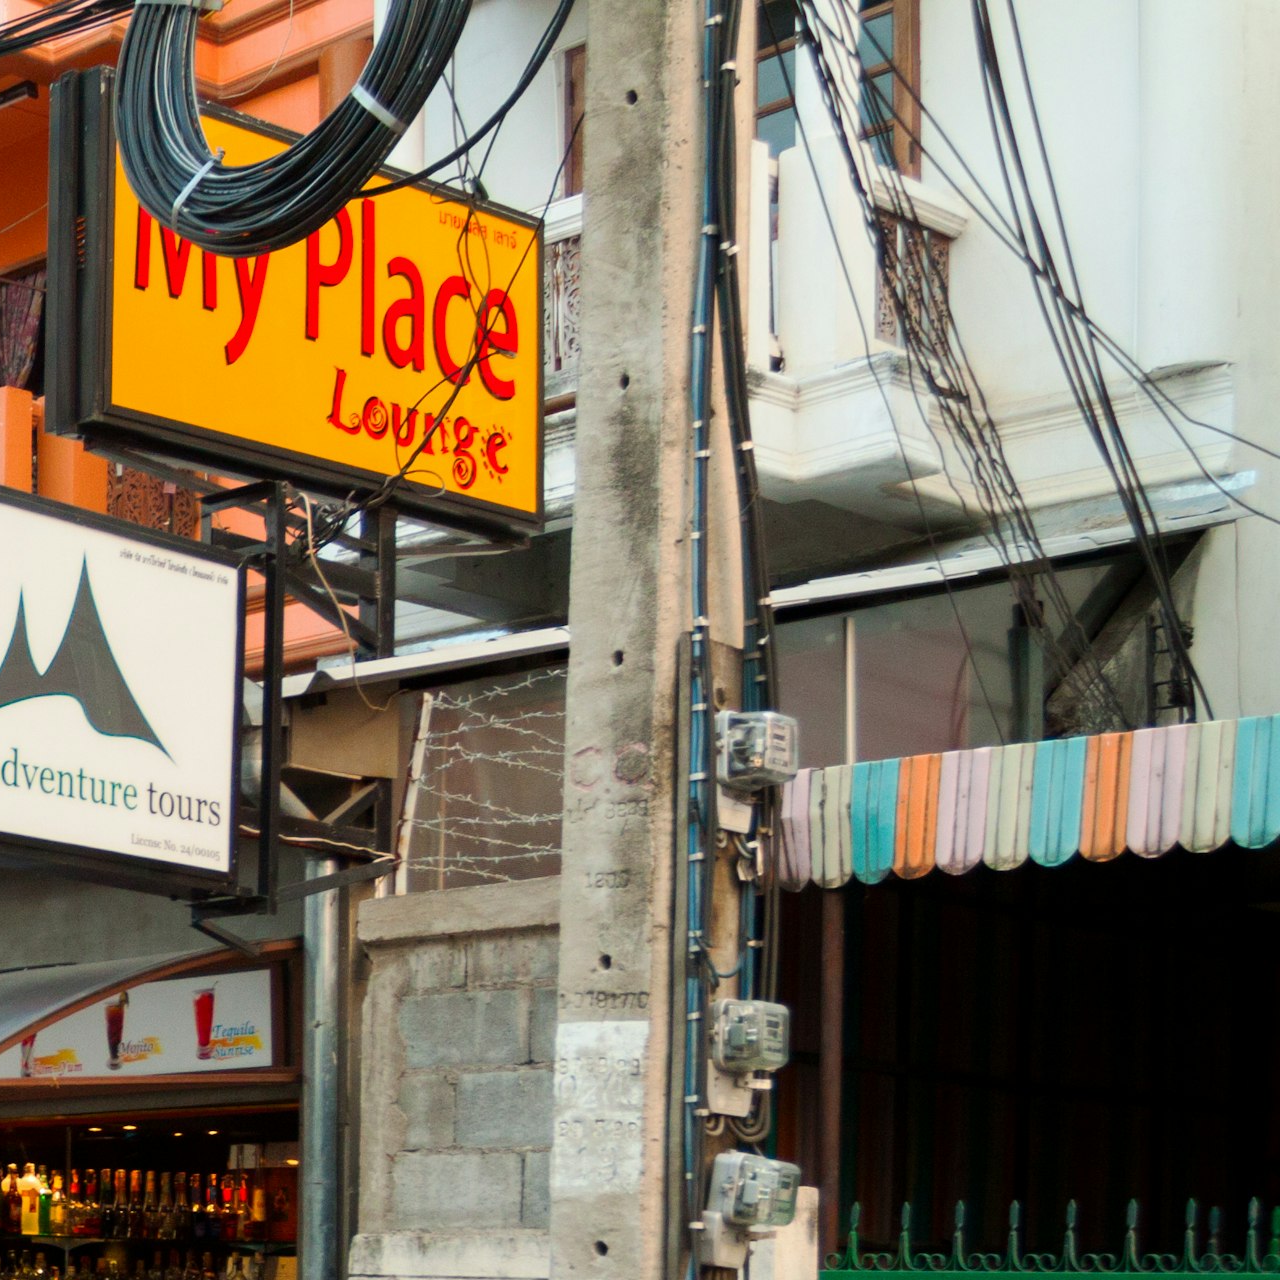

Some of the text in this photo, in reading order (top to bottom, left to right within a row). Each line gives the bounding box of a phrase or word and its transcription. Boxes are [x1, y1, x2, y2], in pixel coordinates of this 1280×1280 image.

[134, 198, 518, 401] My Place
[327, 366, 512, 489] Lounge
[147, 781, 221, 827] tours
[131, 833, 161, 849] License
[164, 838, 177, 852] No.
[213, 1021, 255, 1037] Tequila
[119, 1039, 254, 1059] Mojito Sunrise
